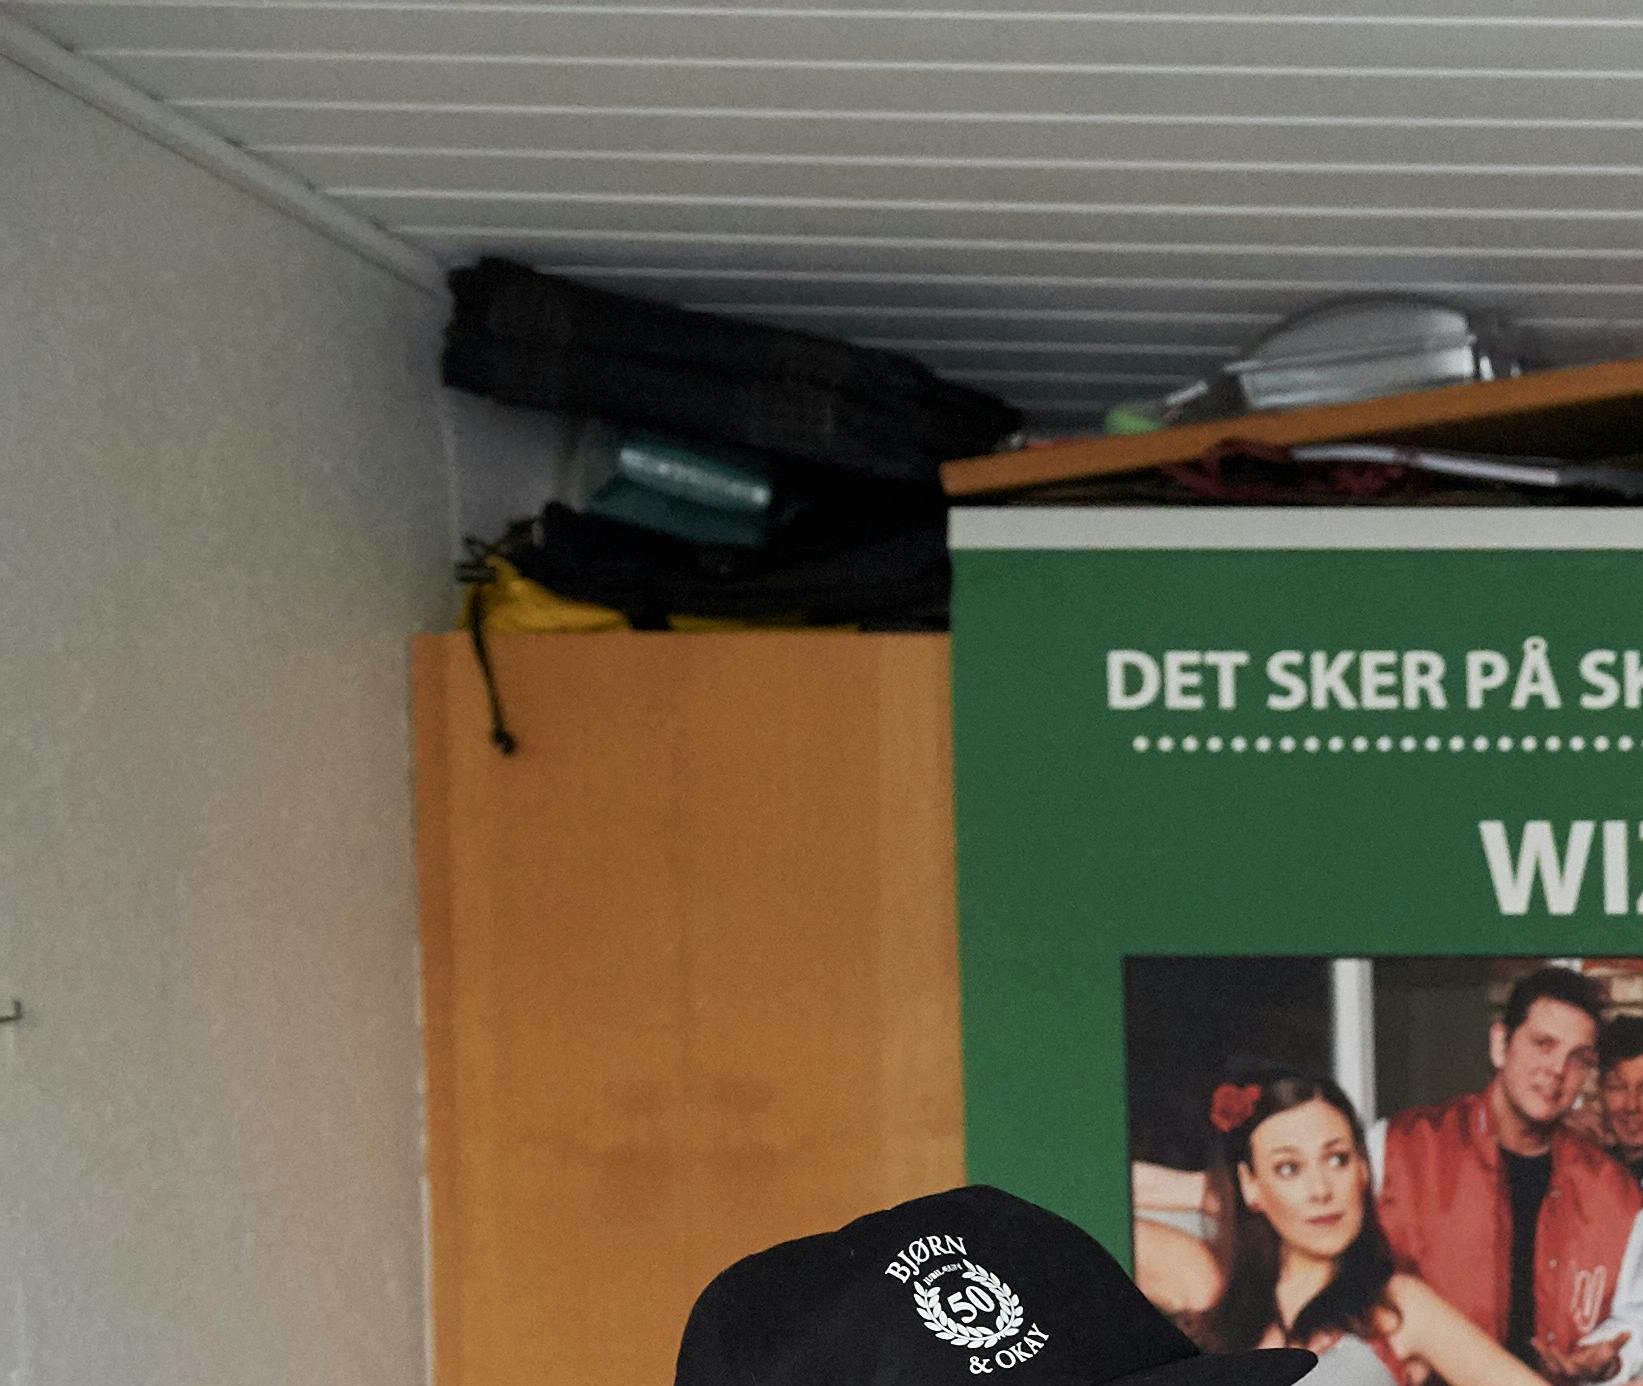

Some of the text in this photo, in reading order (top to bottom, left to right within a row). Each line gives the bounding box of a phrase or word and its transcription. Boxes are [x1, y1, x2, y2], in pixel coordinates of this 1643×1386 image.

[1106, 650, 1248, 710] DET
[1265, 650, 1447, 710] SKER
[1465, 636, 1561, 710] PÅ
[885, 1234, 968, 1284] BJØRN
[946, 1285, 996, 1324] 50
[969, 1322, 1050, 1375] & OKAY
